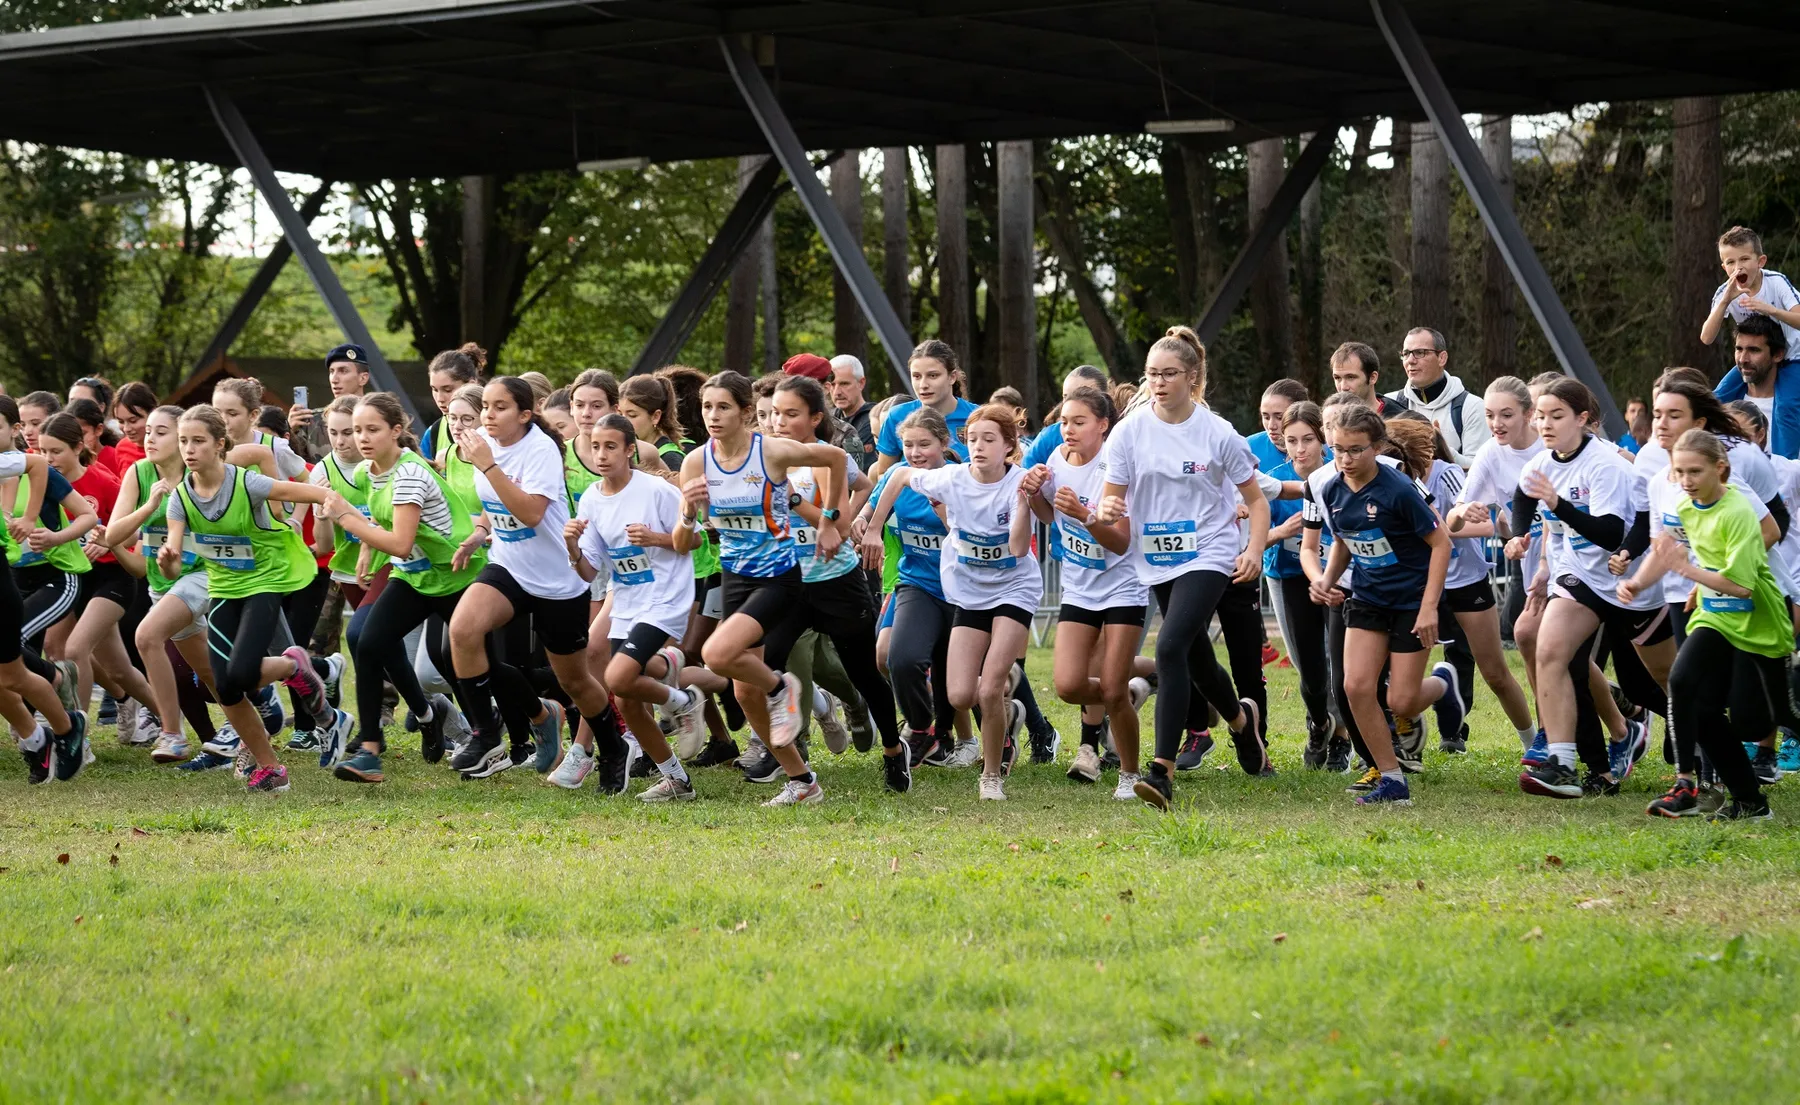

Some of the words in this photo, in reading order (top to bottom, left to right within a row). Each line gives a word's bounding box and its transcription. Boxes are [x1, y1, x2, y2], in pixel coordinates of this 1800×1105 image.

[494, 515, 518, 529] 114
[724, 517, 752, 529] 117
[798, 530, 807, 543] 8
[913, 535, 940, 548] 101
[967, 535, 988, 543] CASAL
[1068, 536, 1089, 556] 167
[1153, 536, 1183, 551] 152
[1353, 542, 1375, 556] 147
[213, 546, 234, 557] 75
[912, 548, 930, 556] CASAL
[972, 546, 1002, 559] 150
[617, 559, 638, 572] 16
